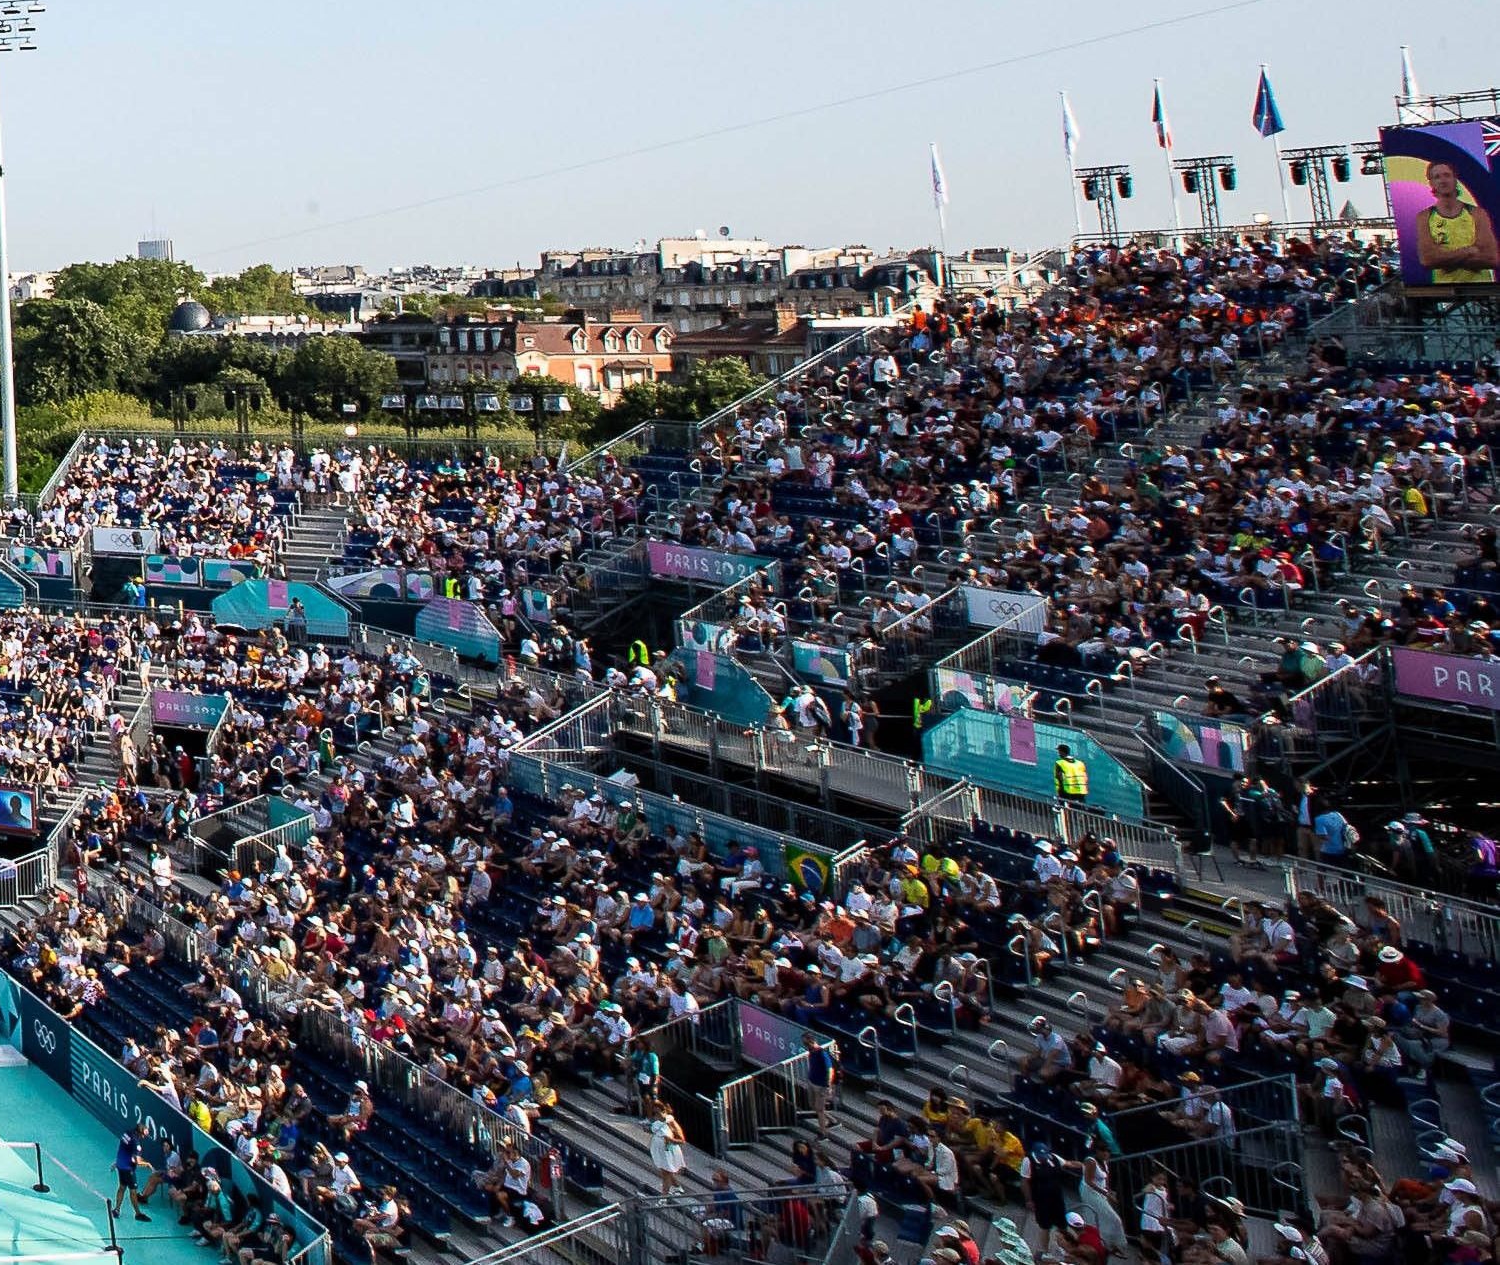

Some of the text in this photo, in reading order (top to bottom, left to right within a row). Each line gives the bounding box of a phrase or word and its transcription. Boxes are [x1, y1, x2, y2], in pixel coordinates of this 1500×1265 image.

[665, 552, 709, 572] PARIS
[1434, 666, 1494, 697] PAR
[159, 702, 190, 713] PARIS
[747, 1023, 785, 1050] PARIS
[83, 1061, 128, 1119] PARIS
